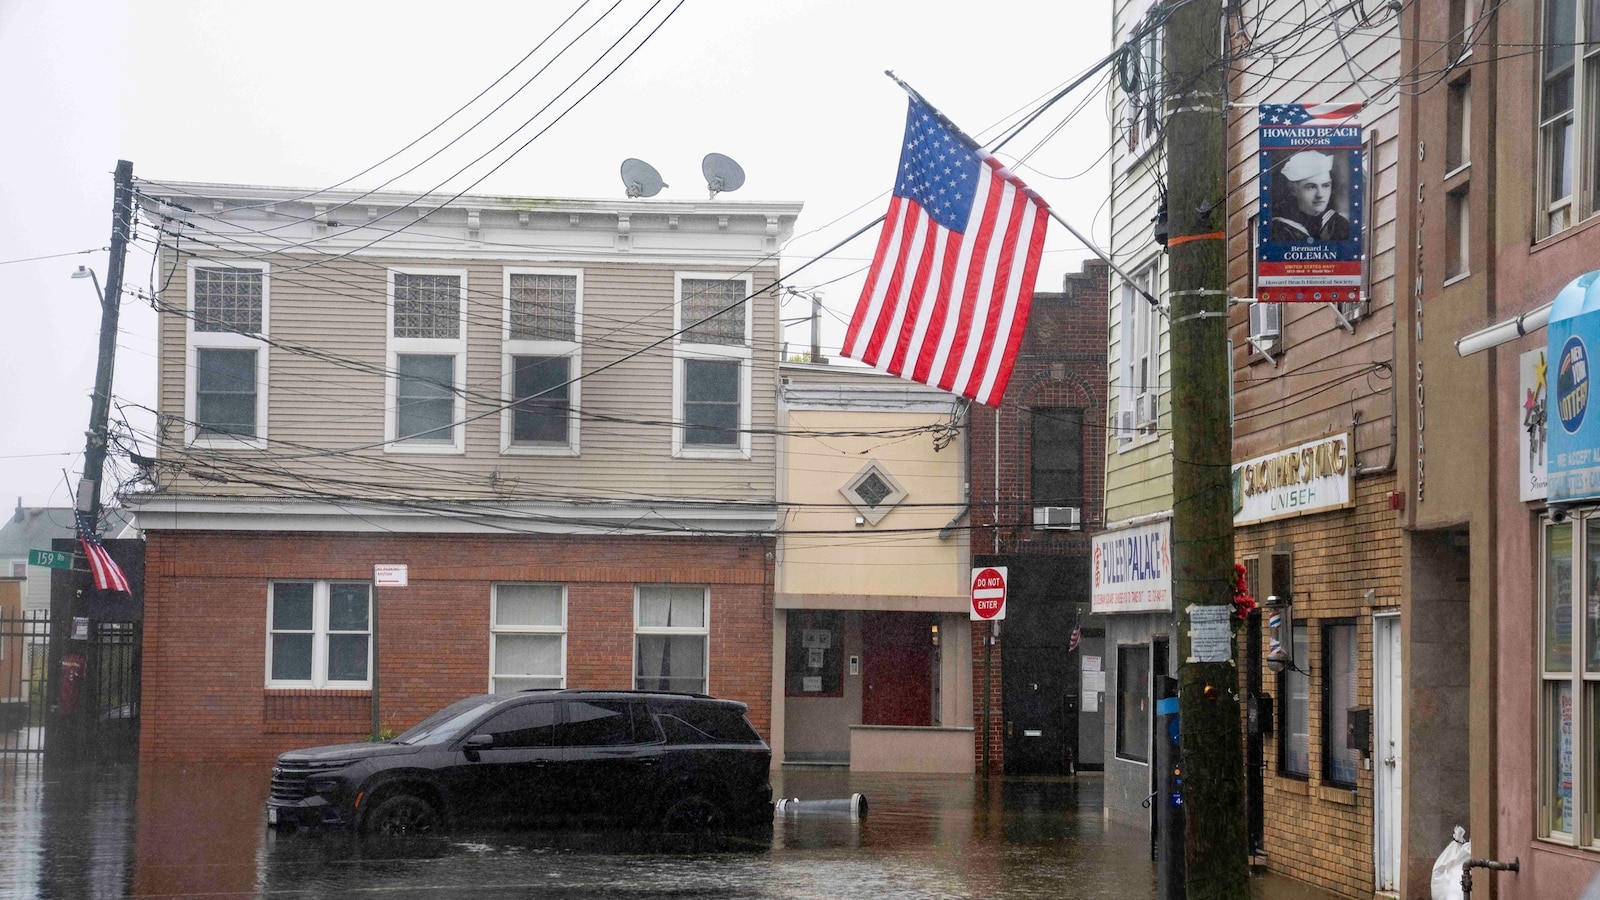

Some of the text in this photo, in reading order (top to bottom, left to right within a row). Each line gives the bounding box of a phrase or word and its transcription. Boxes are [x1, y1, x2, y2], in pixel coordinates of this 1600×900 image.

[1263, 127, 1358, 138] HOWARD BEACH
[1290, 138, 1331, 146] HONORS
[1419, 140, 1425, 161] 8
[1283, 251, 1337, 260] COLEMAN
[1416, 360, 1424, 502] SQUARE
[37, 552, 54, 565] 159
[1102, 532, 1161, 585] FULEEN PALACE
[977, 577, 1000, 587] DO NOT
[977, 600, 998, 610] ENTER
